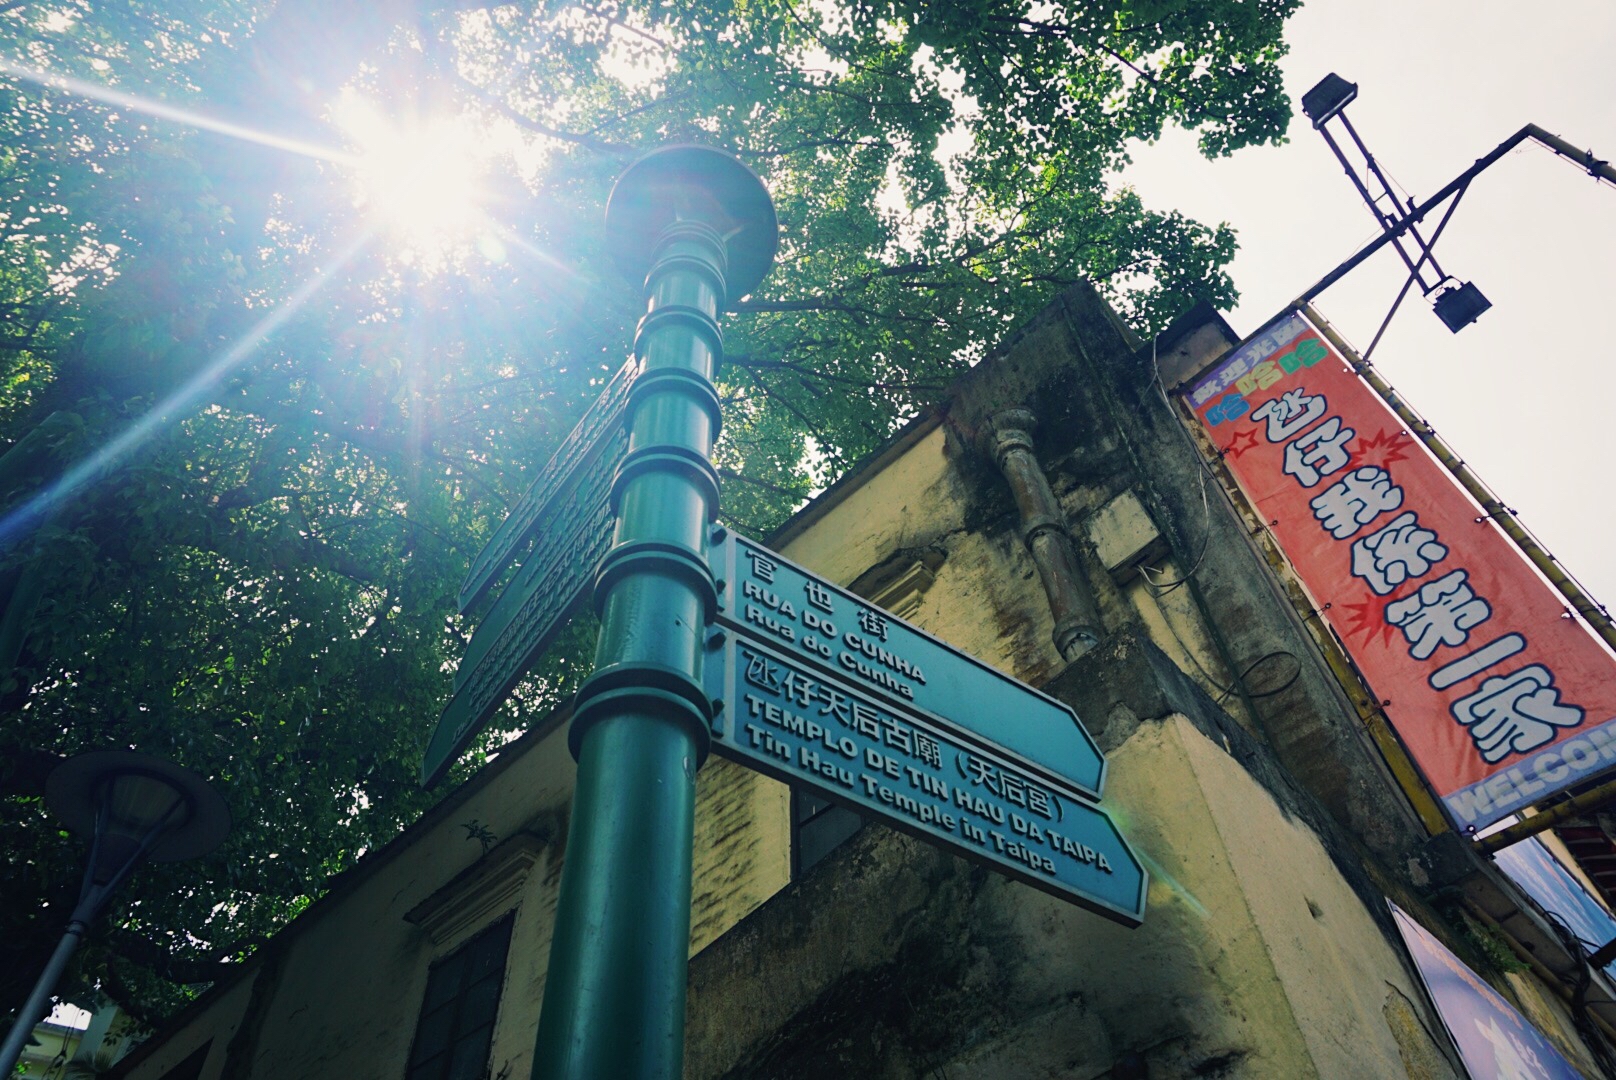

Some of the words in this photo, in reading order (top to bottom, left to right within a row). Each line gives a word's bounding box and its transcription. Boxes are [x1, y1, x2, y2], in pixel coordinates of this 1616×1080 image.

[557, 567, 576, 596] DA
[746, 549, 888, 642] 官也街
[1250, 387, 1587, 764] 氹仔我係第一家
[744, 580, 797, 621] RUA
[803, 609, 838, 639] DO
[843, 631, 927, 685] CUNHA
[746, 604, 796, 644] Rua
[802, 635, 833, 658] do
[838, 650, 914, 700] Cunha
[745, 693, 859, 758] TEMPLO
[864, 747, 901, 778] DE
[904, 766, 949, 802] TIN
[952, 788, 1005, 826] HAU
[1009, 813, 1045, 843] DA
[1046, 828, 1113, 874] TAIPA
[745, 723, 791, 760] Tin
[799, 747, 854, 787] Hau
[860, 773, 956, 830] Temple
[960, 817, 986, 846] in
[989, 830, 1056, 876] Taipa
